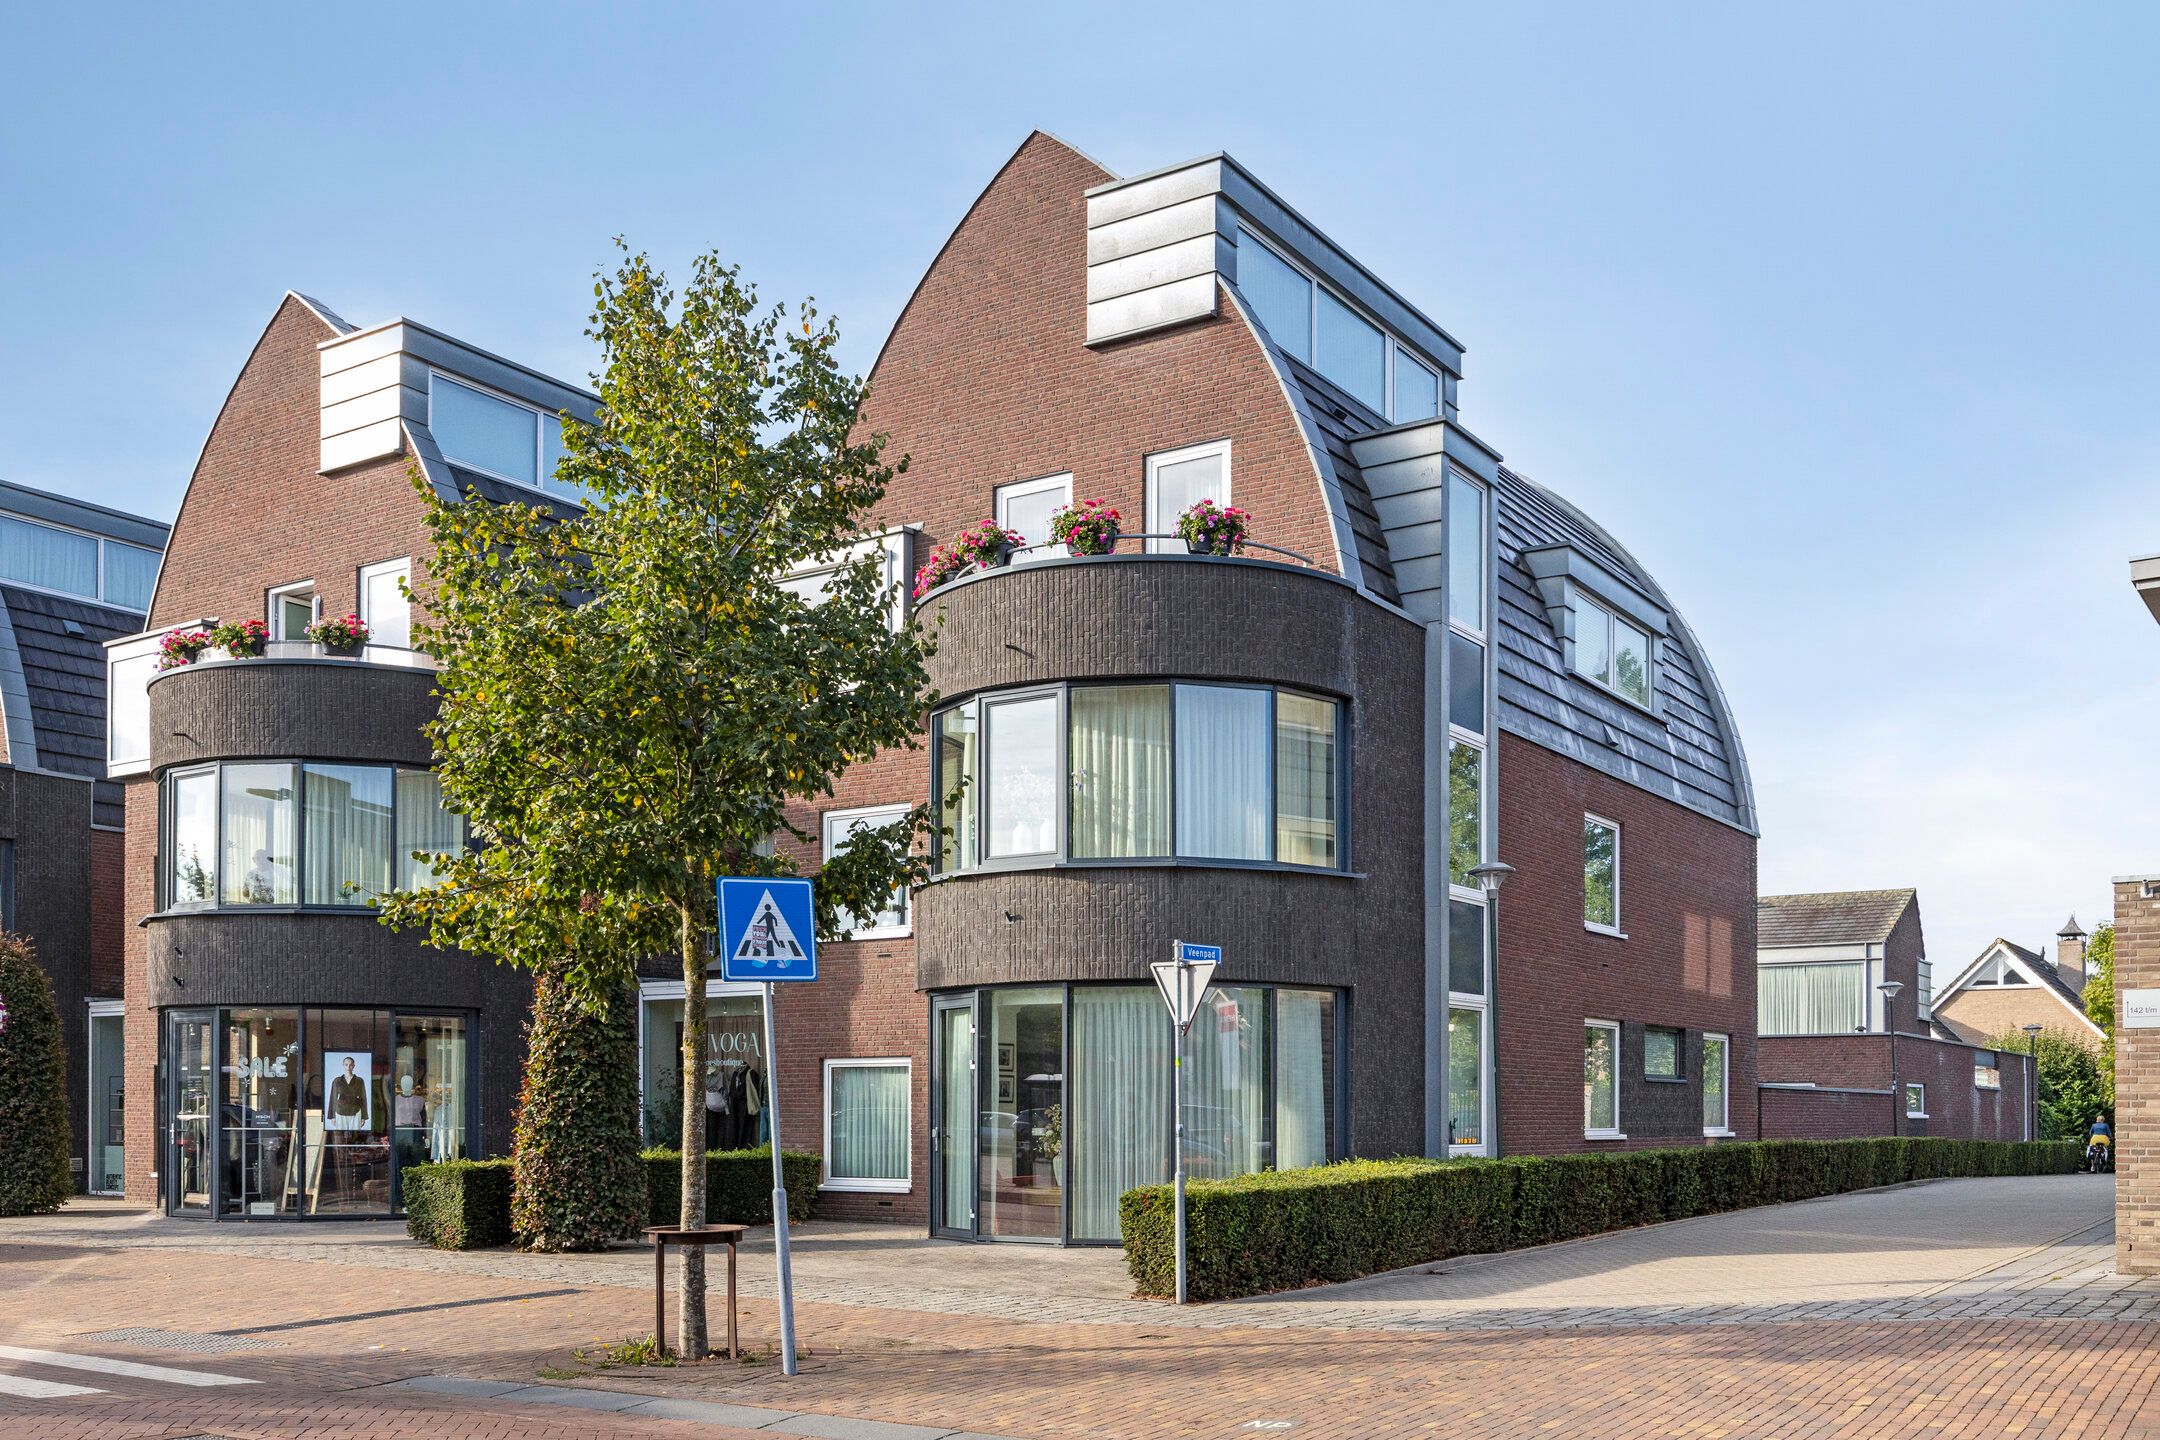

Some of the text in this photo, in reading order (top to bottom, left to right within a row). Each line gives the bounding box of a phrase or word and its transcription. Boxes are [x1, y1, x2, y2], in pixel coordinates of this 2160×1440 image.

[1188, 947, 1216, 959] Veenpad
[2130, 1006, 2158, 1014] 142 t/m
[236, 1055, 288, 1078] SALE
